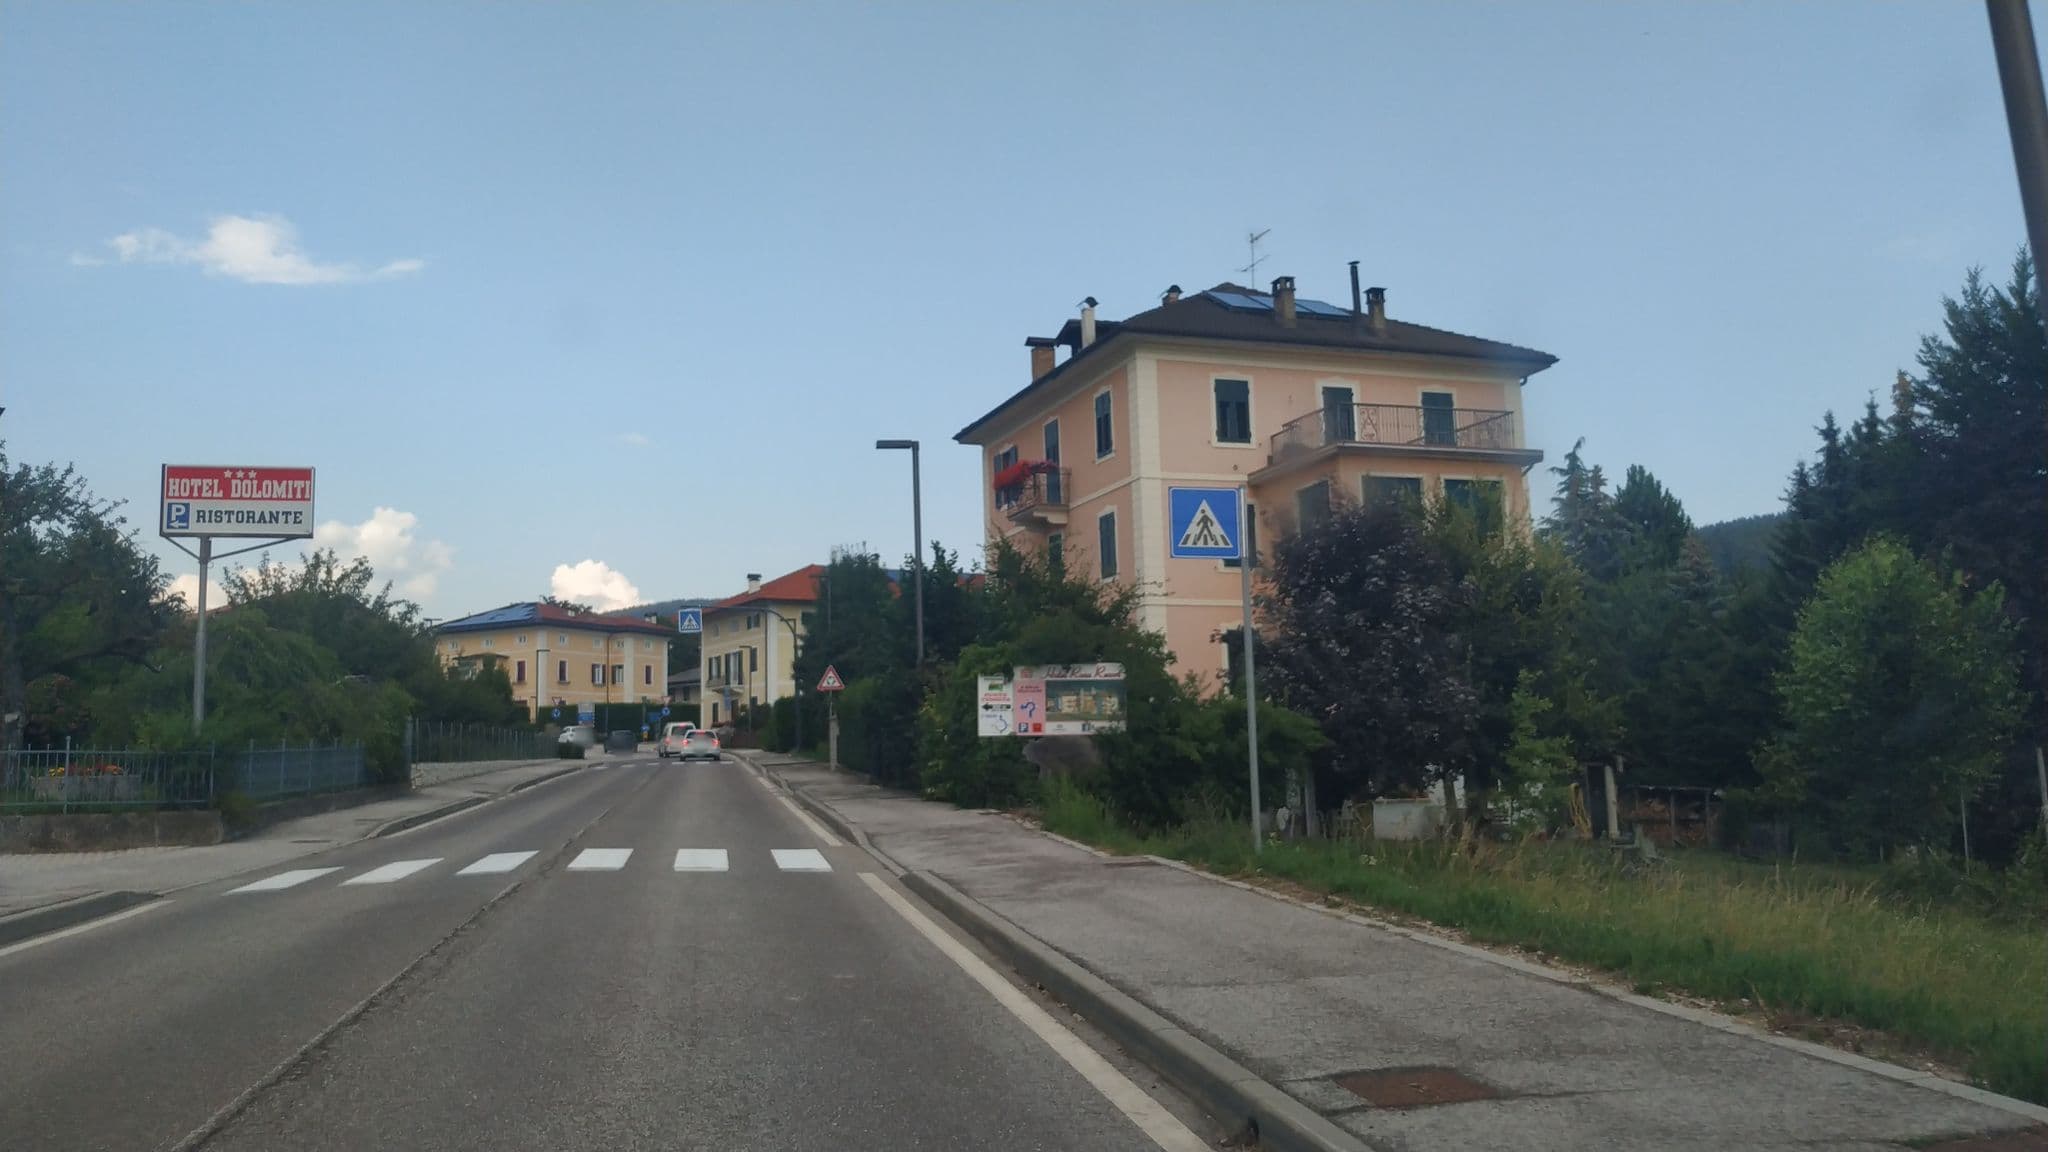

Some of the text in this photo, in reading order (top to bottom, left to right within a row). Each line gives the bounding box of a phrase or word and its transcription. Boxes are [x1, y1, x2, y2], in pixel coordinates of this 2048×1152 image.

[168, 478, 311, 498] HOTEL DOLOMITI
[171, 504, 186, 521] P
[196, 510, 303, 524] RISTORANTE
